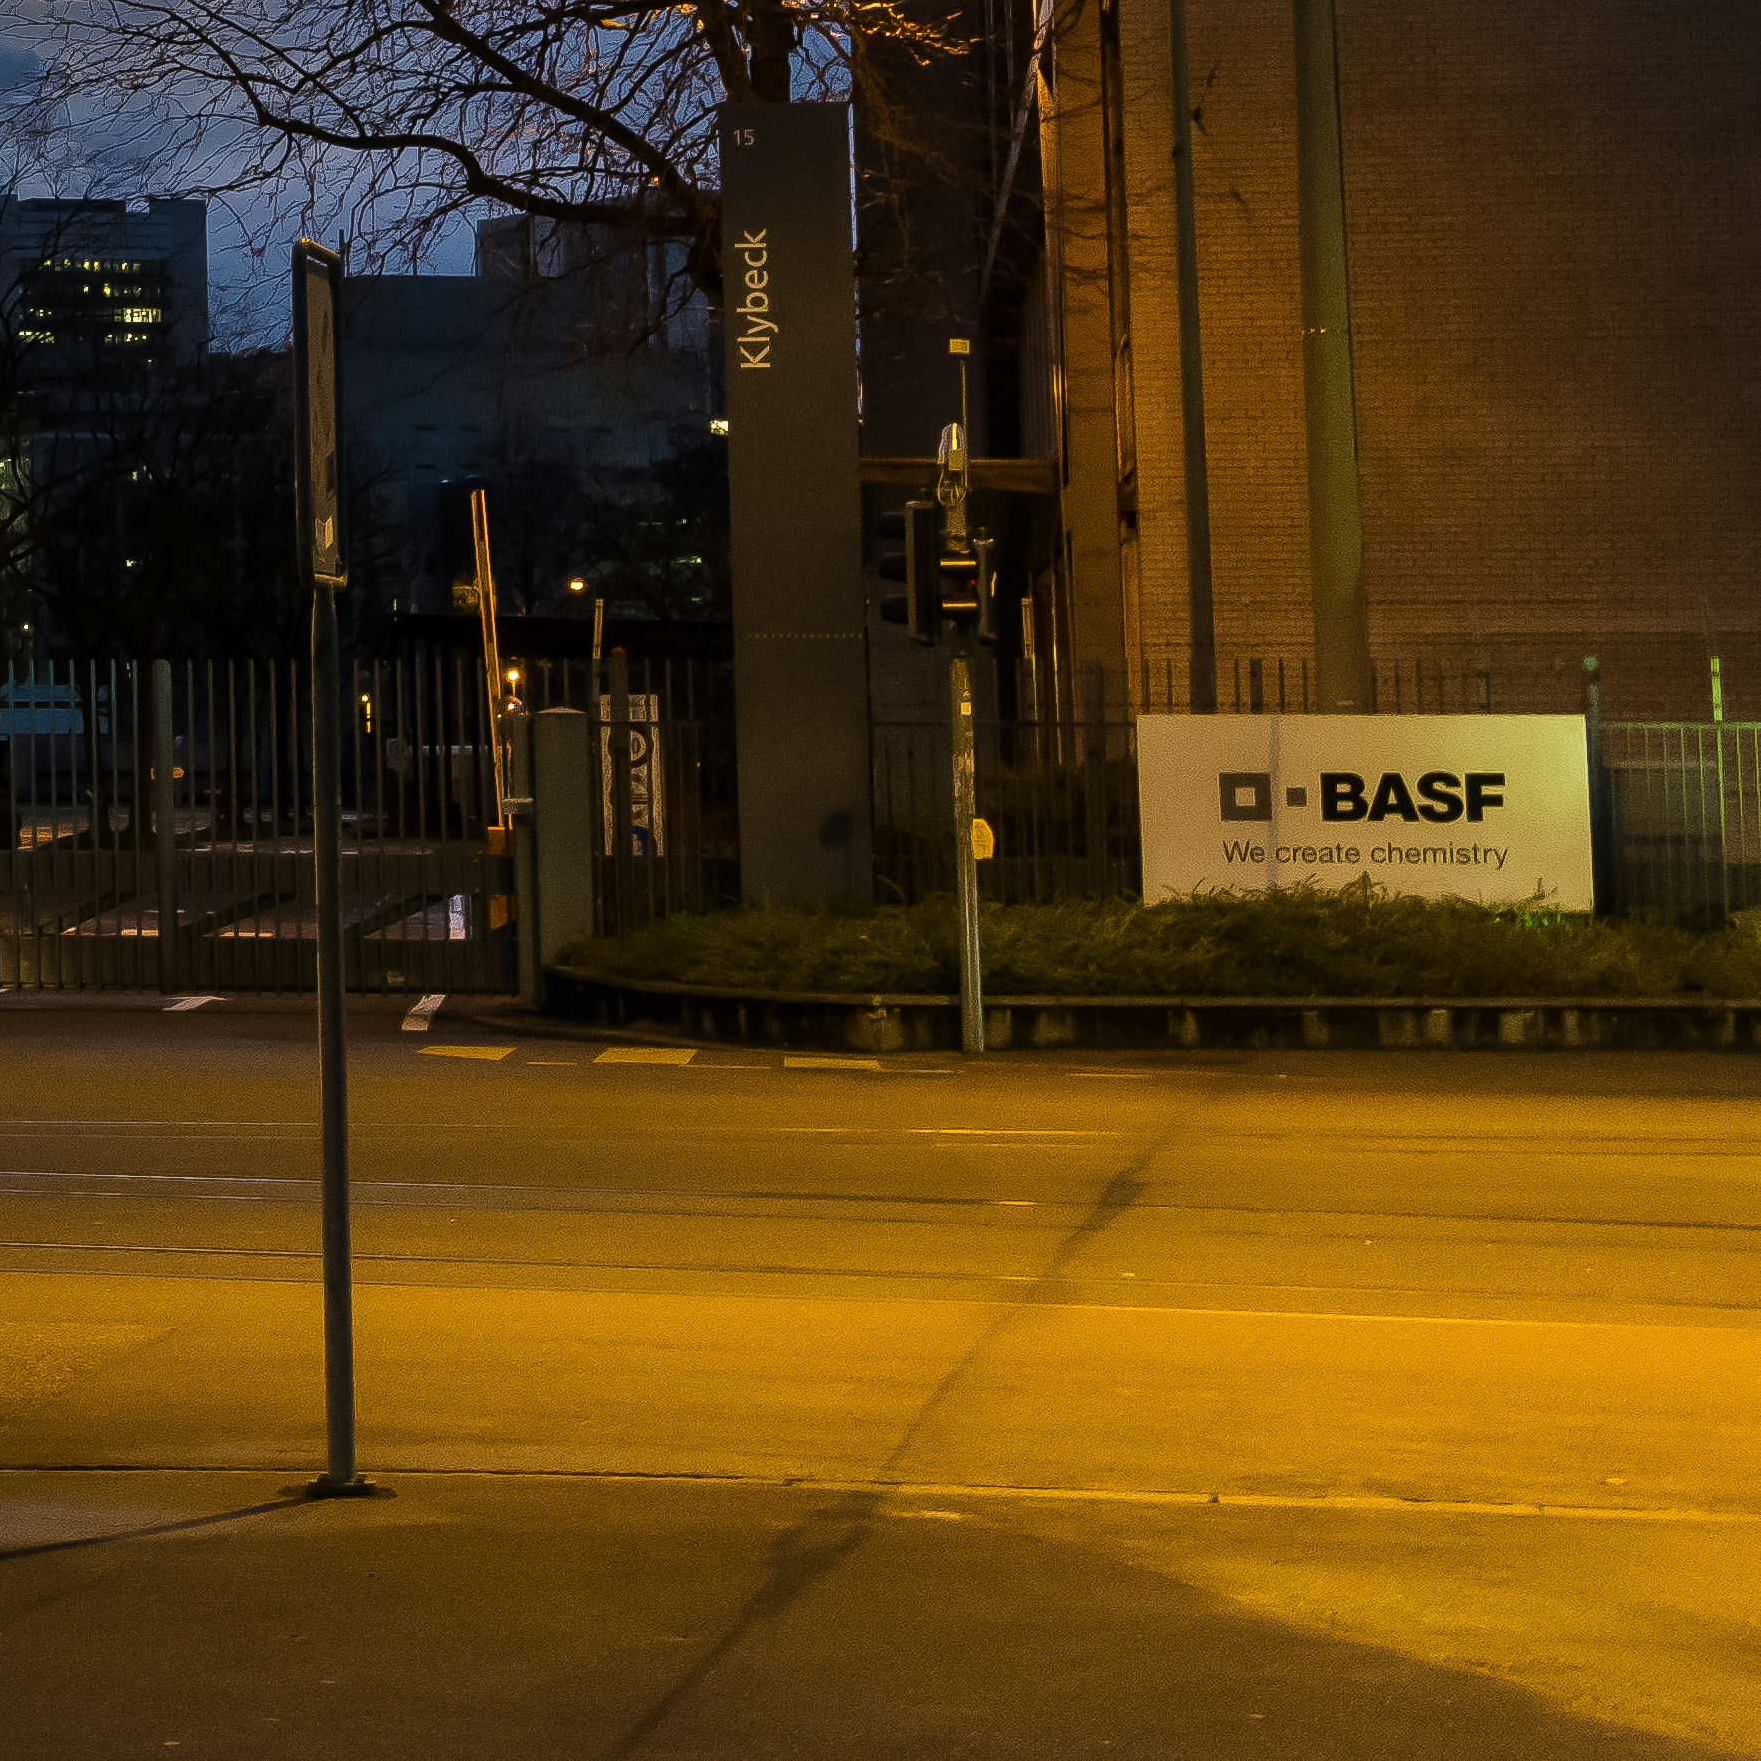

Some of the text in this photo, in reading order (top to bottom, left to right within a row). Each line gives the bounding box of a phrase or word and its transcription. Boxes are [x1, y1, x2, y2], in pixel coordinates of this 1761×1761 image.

[733, 129, 755, 146] 15
[734, 228, 779, 369] Klybeck
[1319, 771, 1507, 823] BASF
[1222, 840, 1509, 871] We create chemistry
